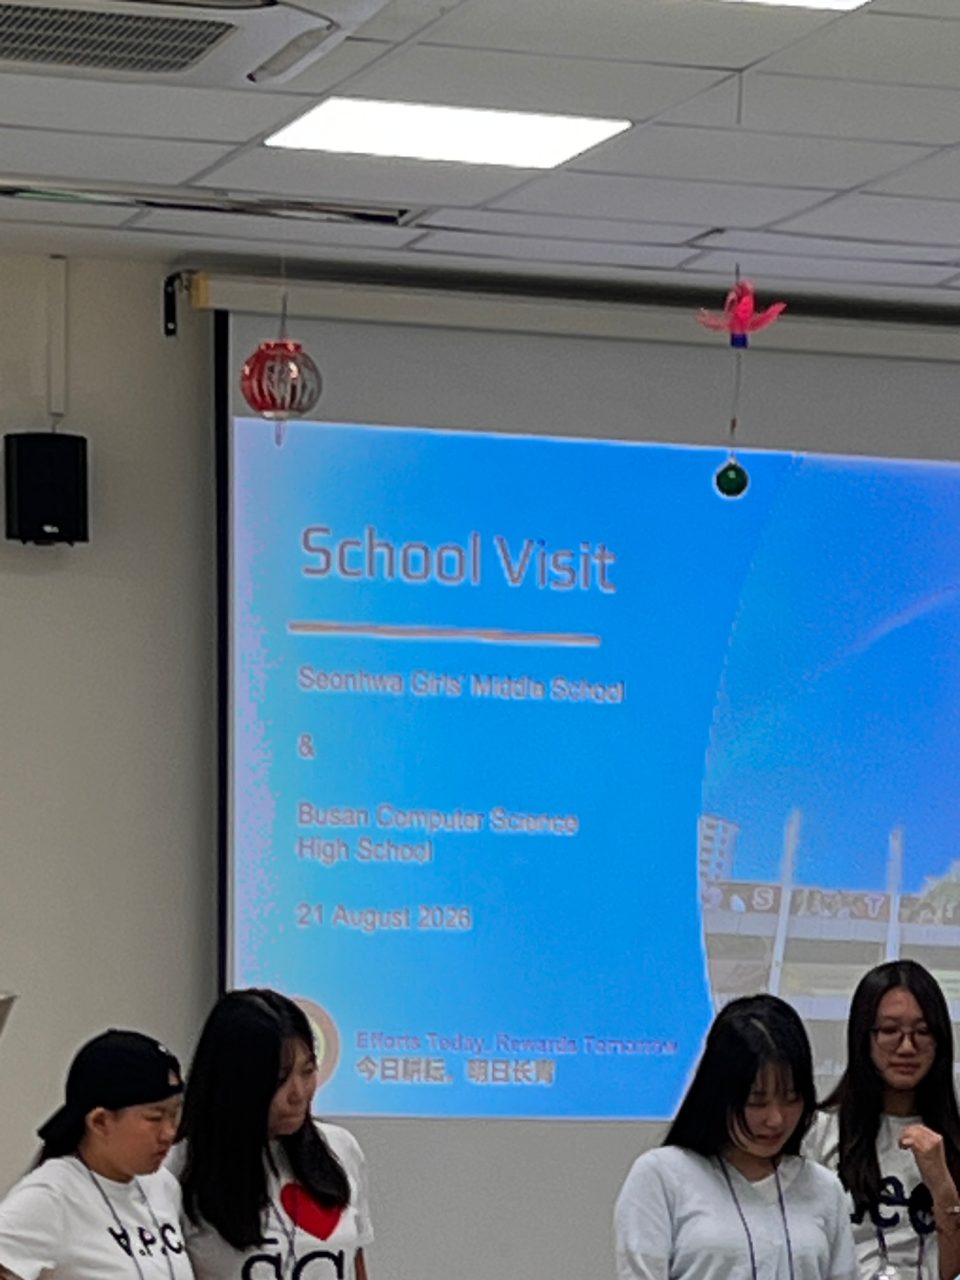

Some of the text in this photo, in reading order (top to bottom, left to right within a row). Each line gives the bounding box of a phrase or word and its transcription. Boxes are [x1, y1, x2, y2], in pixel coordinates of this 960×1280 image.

[301, 525, 618, 593] School Visit
[298, 666, 404, 693] Seonhwa
[471, 673, 545, 699] Middle
[550, 677, 625, 704] School
[298, 733, 316, 760] &
[298, 802, 579, 836] Busan Computer Science
[297, 836, 433, 866] High School
[297, 904, 473, 933] 21 August 2026
[356, 1030, 422, 1050] Efforts
[495, 1033, 578, 1054] Rewards
[583, 1034, 679, 1055] Tomorrow
